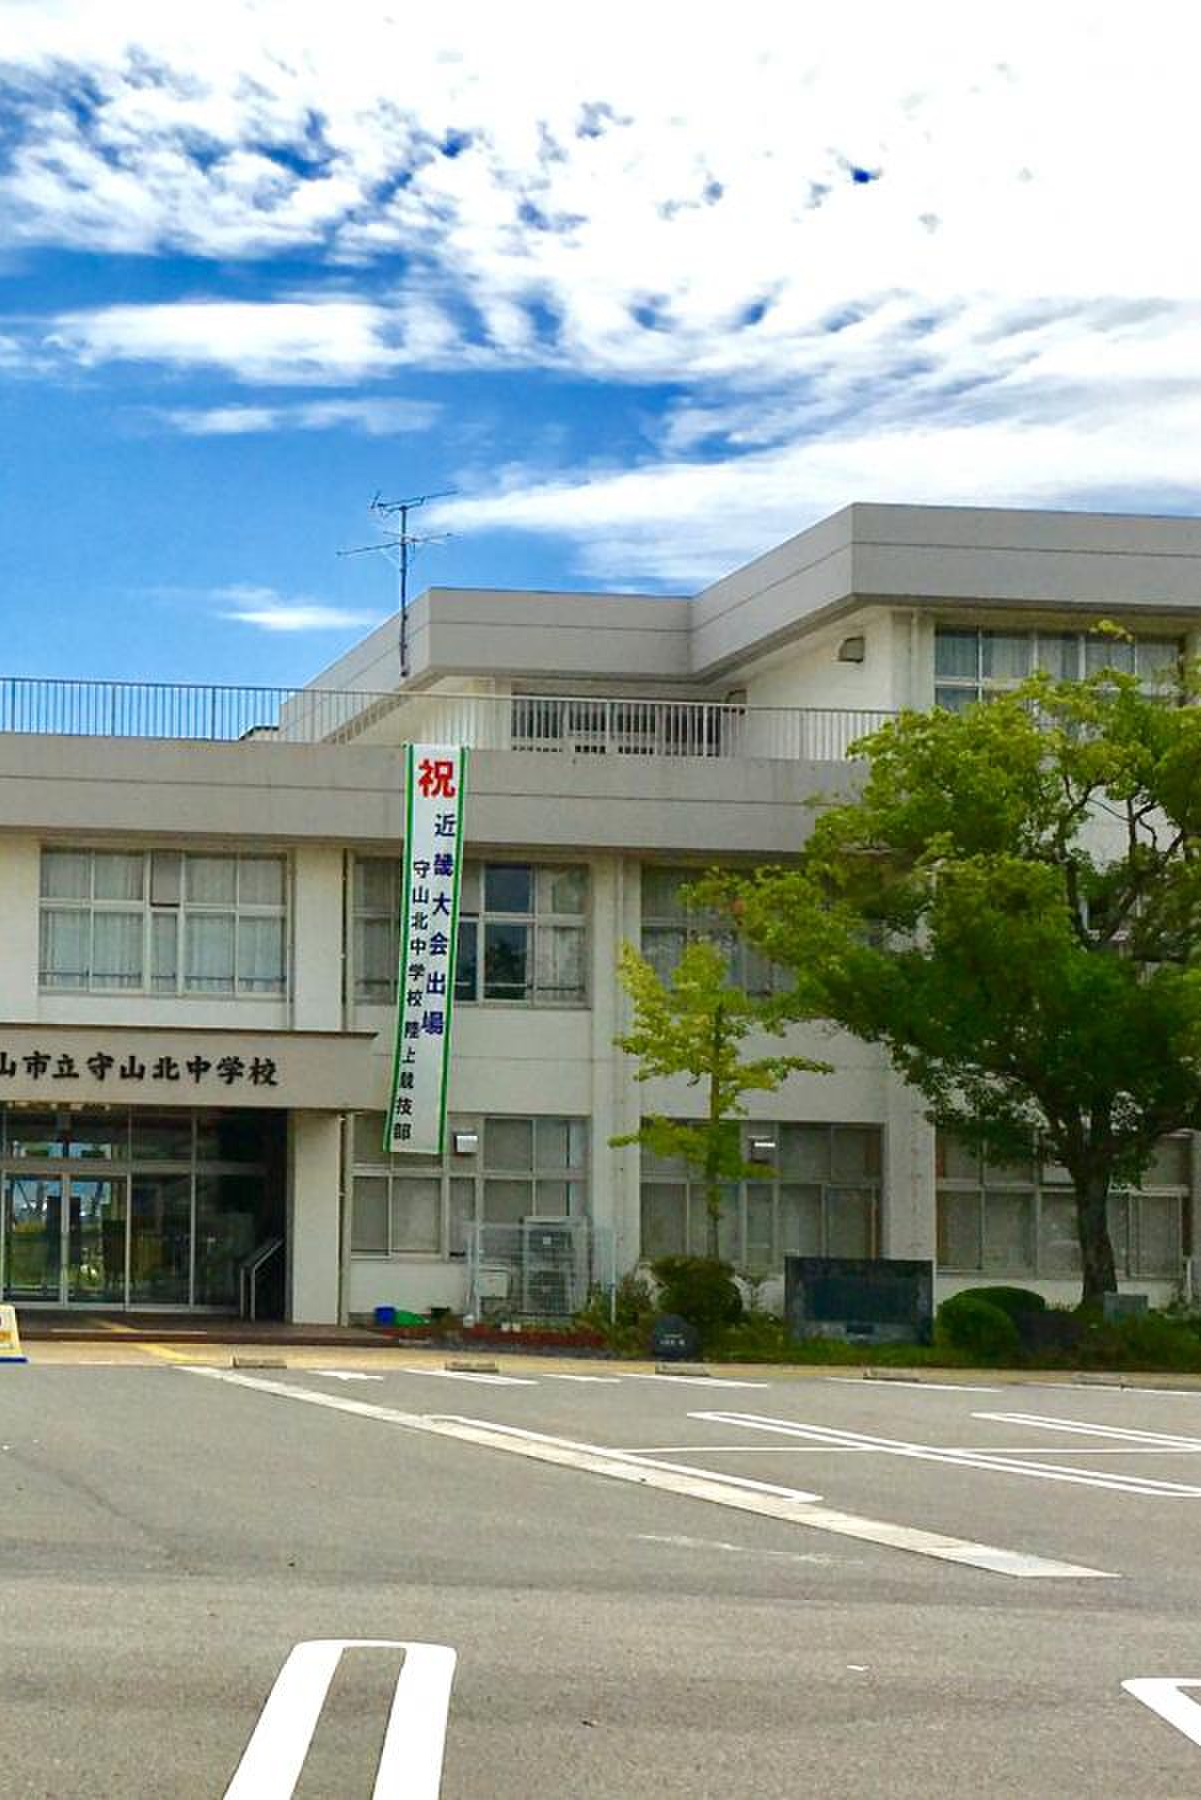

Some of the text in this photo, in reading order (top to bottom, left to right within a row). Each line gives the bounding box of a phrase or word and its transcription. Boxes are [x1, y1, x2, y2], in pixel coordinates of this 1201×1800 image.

[418, 758, 457, 799] 祝
[421, 813, 457, 1036] 近畿大会出場
